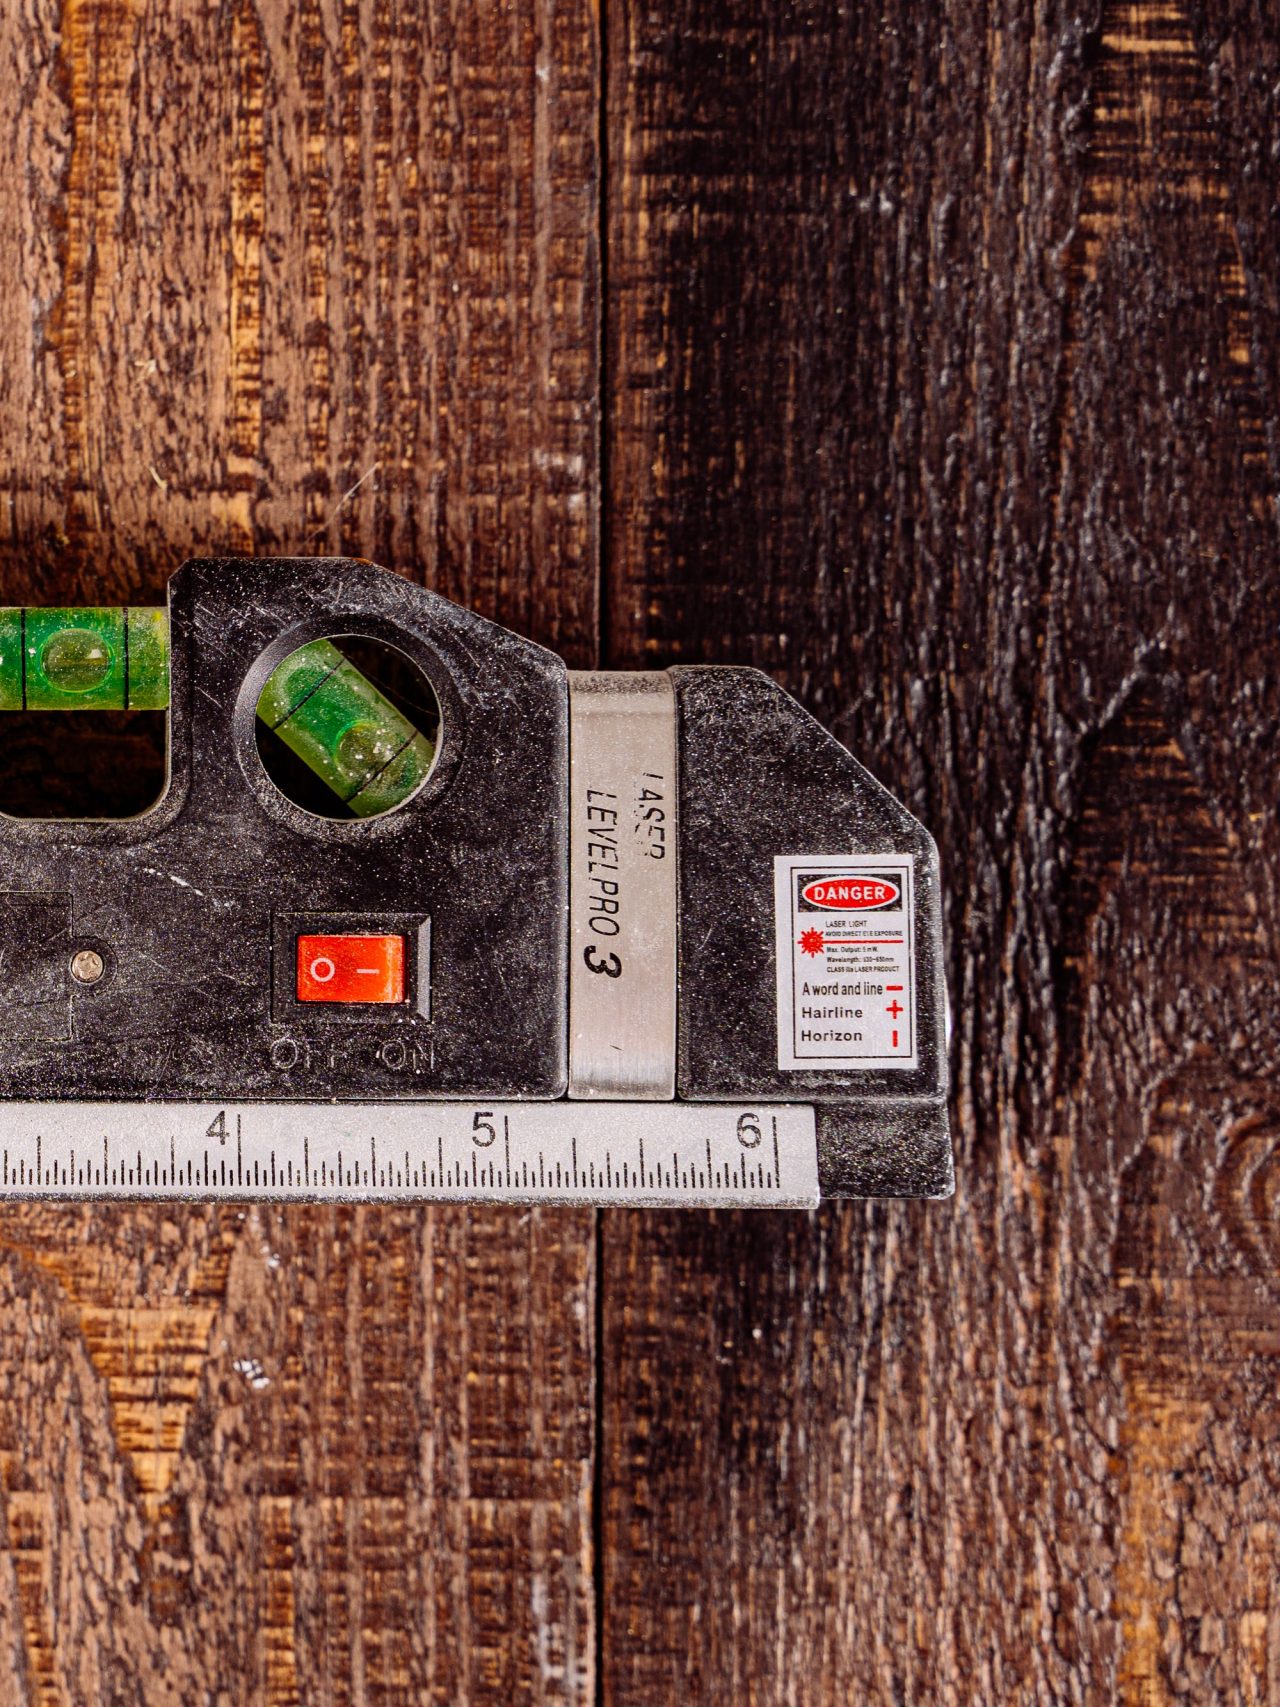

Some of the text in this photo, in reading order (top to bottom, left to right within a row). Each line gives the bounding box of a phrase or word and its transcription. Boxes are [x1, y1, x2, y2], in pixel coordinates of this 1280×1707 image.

[583, 788, 623, 979] LEVELPRO 3
[813, 886, 886, 900] DANGER
[825, 920, 868, 928] LASER LIGHT
[873, 965, 900, 973] PRODUCT
[802, 981, 883, 996] A word and line
[801, 1007, 863, 1019] Hairline
[801, 1030, 863, 1042] Horizon
[205, 1110, 230, 1146] 4
[471, 1111, 496, 1147] 5
[736, 1112, 761, 1148] 6
